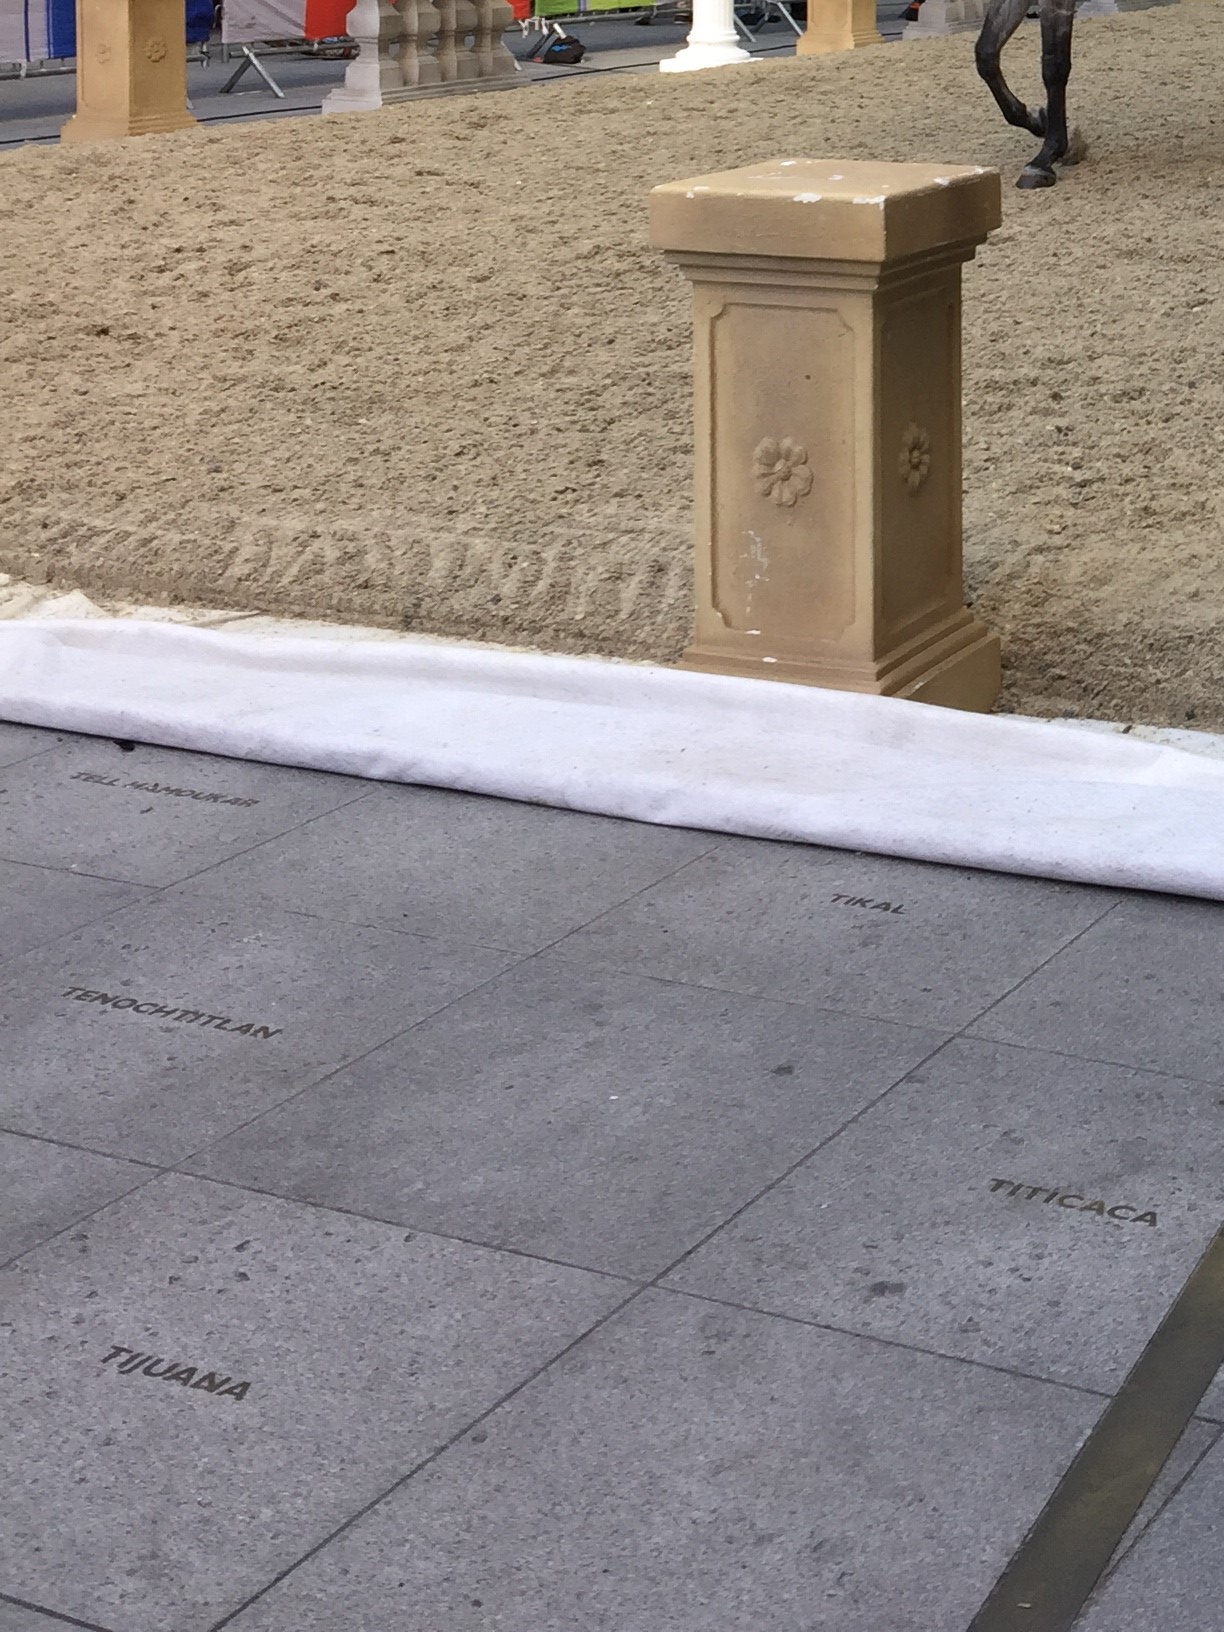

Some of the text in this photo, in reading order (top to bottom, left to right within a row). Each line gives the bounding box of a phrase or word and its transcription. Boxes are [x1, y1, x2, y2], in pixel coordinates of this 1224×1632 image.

[830, 893, 906, 915] TIKAL
[61, 986, 283, 1039] TENOCHTITLAN
[989, 1178, 1158, 1227] TITICACA
[101, 1345, 252, 1401] TIJUANA
